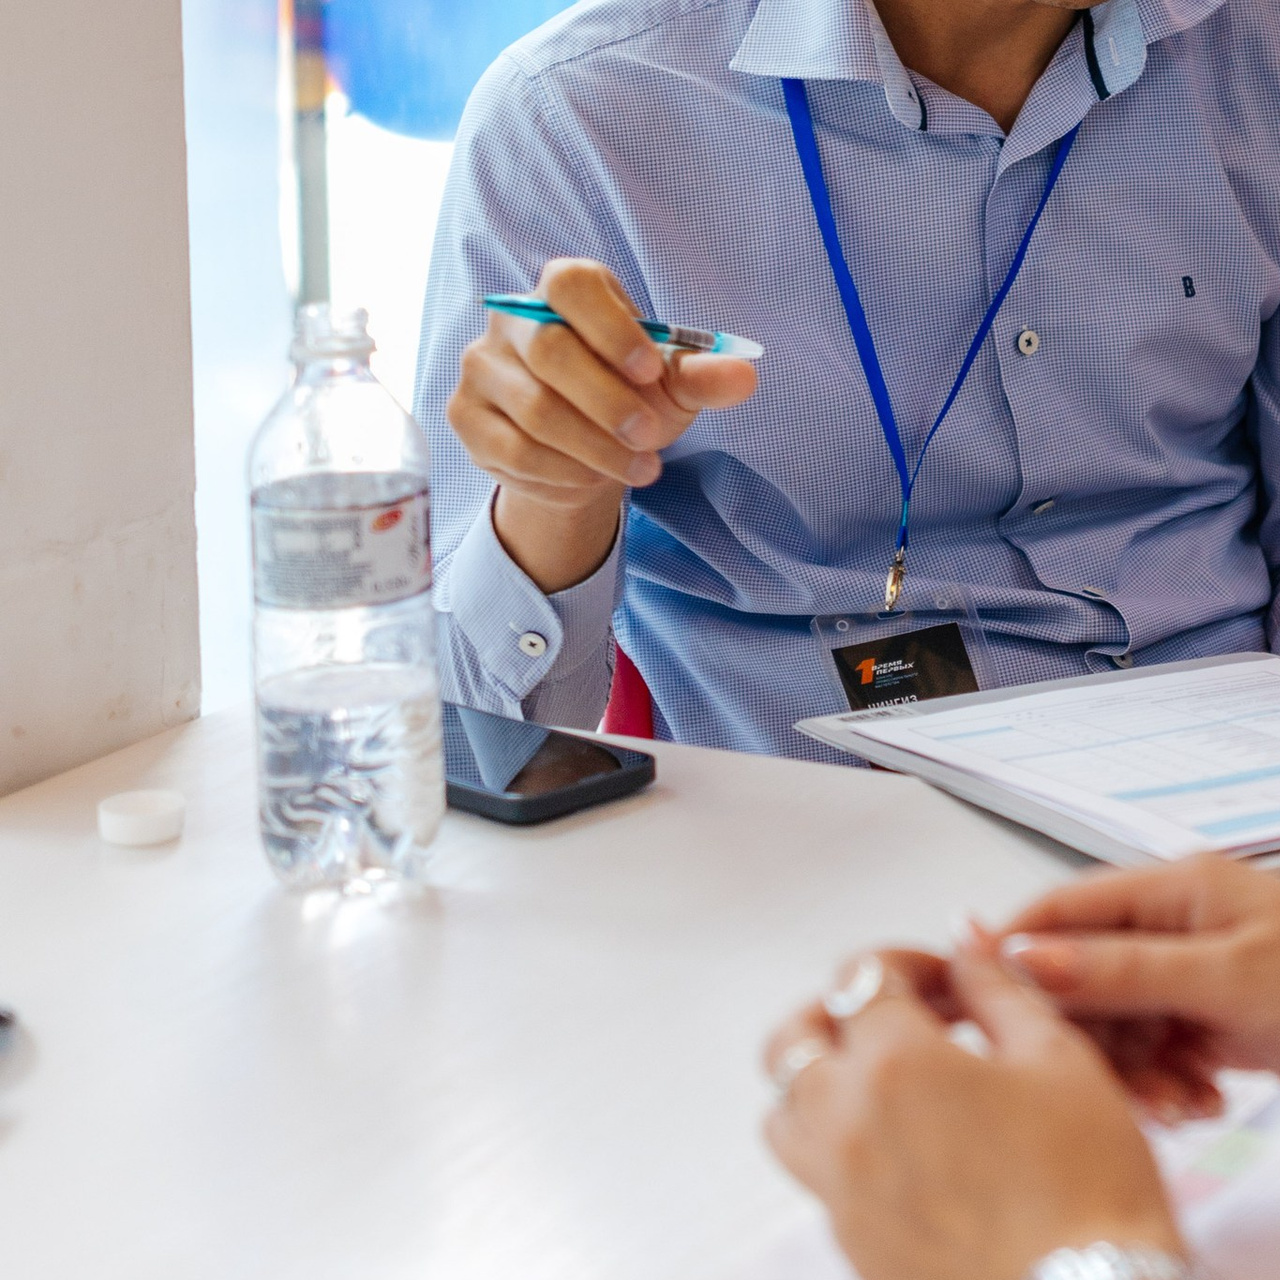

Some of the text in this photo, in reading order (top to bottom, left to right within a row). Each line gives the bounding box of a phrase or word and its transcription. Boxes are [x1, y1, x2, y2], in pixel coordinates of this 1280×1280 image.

[1181, 275, 1196, 298] B
[871, 659, 903, 671] ВРЕМЯ
[876, 661, 915, 675] ПЕРВЫХ
